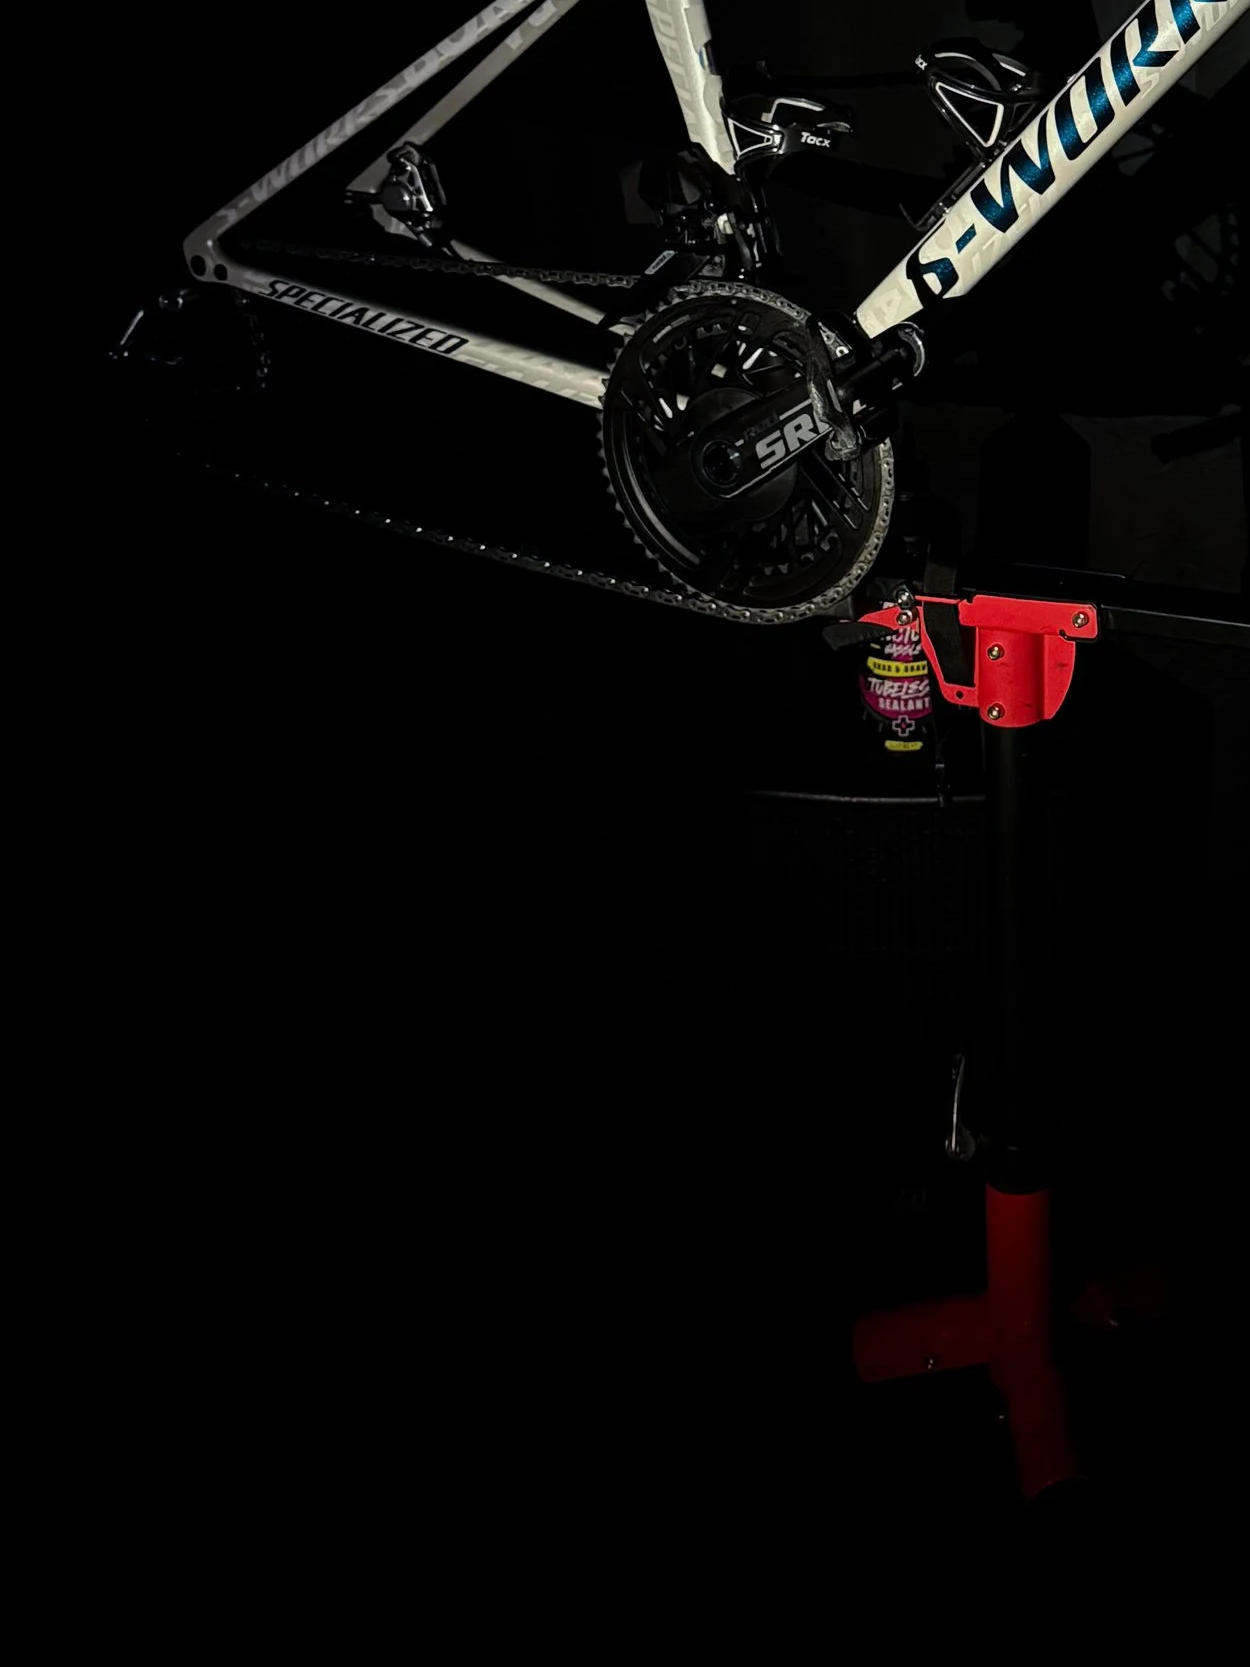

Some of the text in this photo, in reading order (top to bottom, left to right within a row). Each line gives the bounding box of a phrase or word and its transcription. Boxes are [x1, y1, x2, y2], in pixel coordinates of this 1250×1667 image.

[800, 131, 832, 148] Tacx
[258, 279, 469, 354] SPECIALIZED
[878, 697, 930, 711] SEALANT
